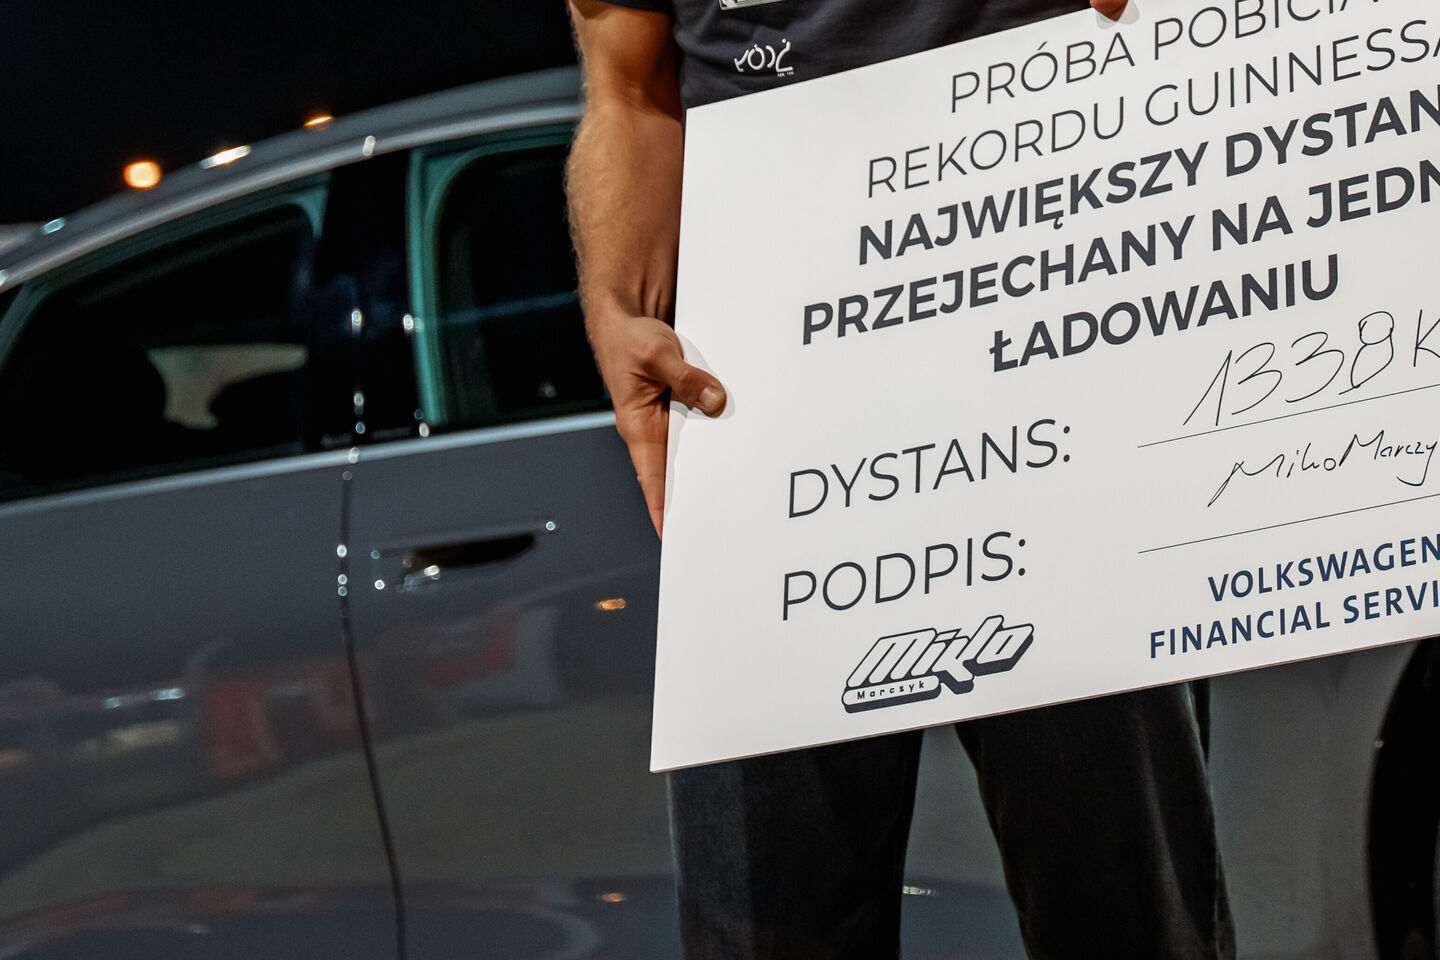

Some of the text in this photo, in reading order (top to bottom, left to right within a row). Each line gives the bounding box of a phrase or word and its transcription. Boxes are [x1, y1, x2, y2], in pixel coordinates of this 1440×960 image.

[951, 31, 1136, 114] PRÓBA
[868, 95, 1124, 199] REKORDU
[859, 140, 1209, 266] NAJWIĘKSZY
[802, 214, 1196, 346] PRZEJECHANY
[1211, 194, 1294, 252] NA
[988, 253, 1339, 373] ŁADOWANIU
[1183, 310, 1395, 427] 1338
[788, 418, 1072, 519] DYSTANS:
[782, 531, 1027, 622] PODPIS:
[1150, 601, 1331, 659] FINANCIAL
[857, 680, 925, 701] Marczyk
